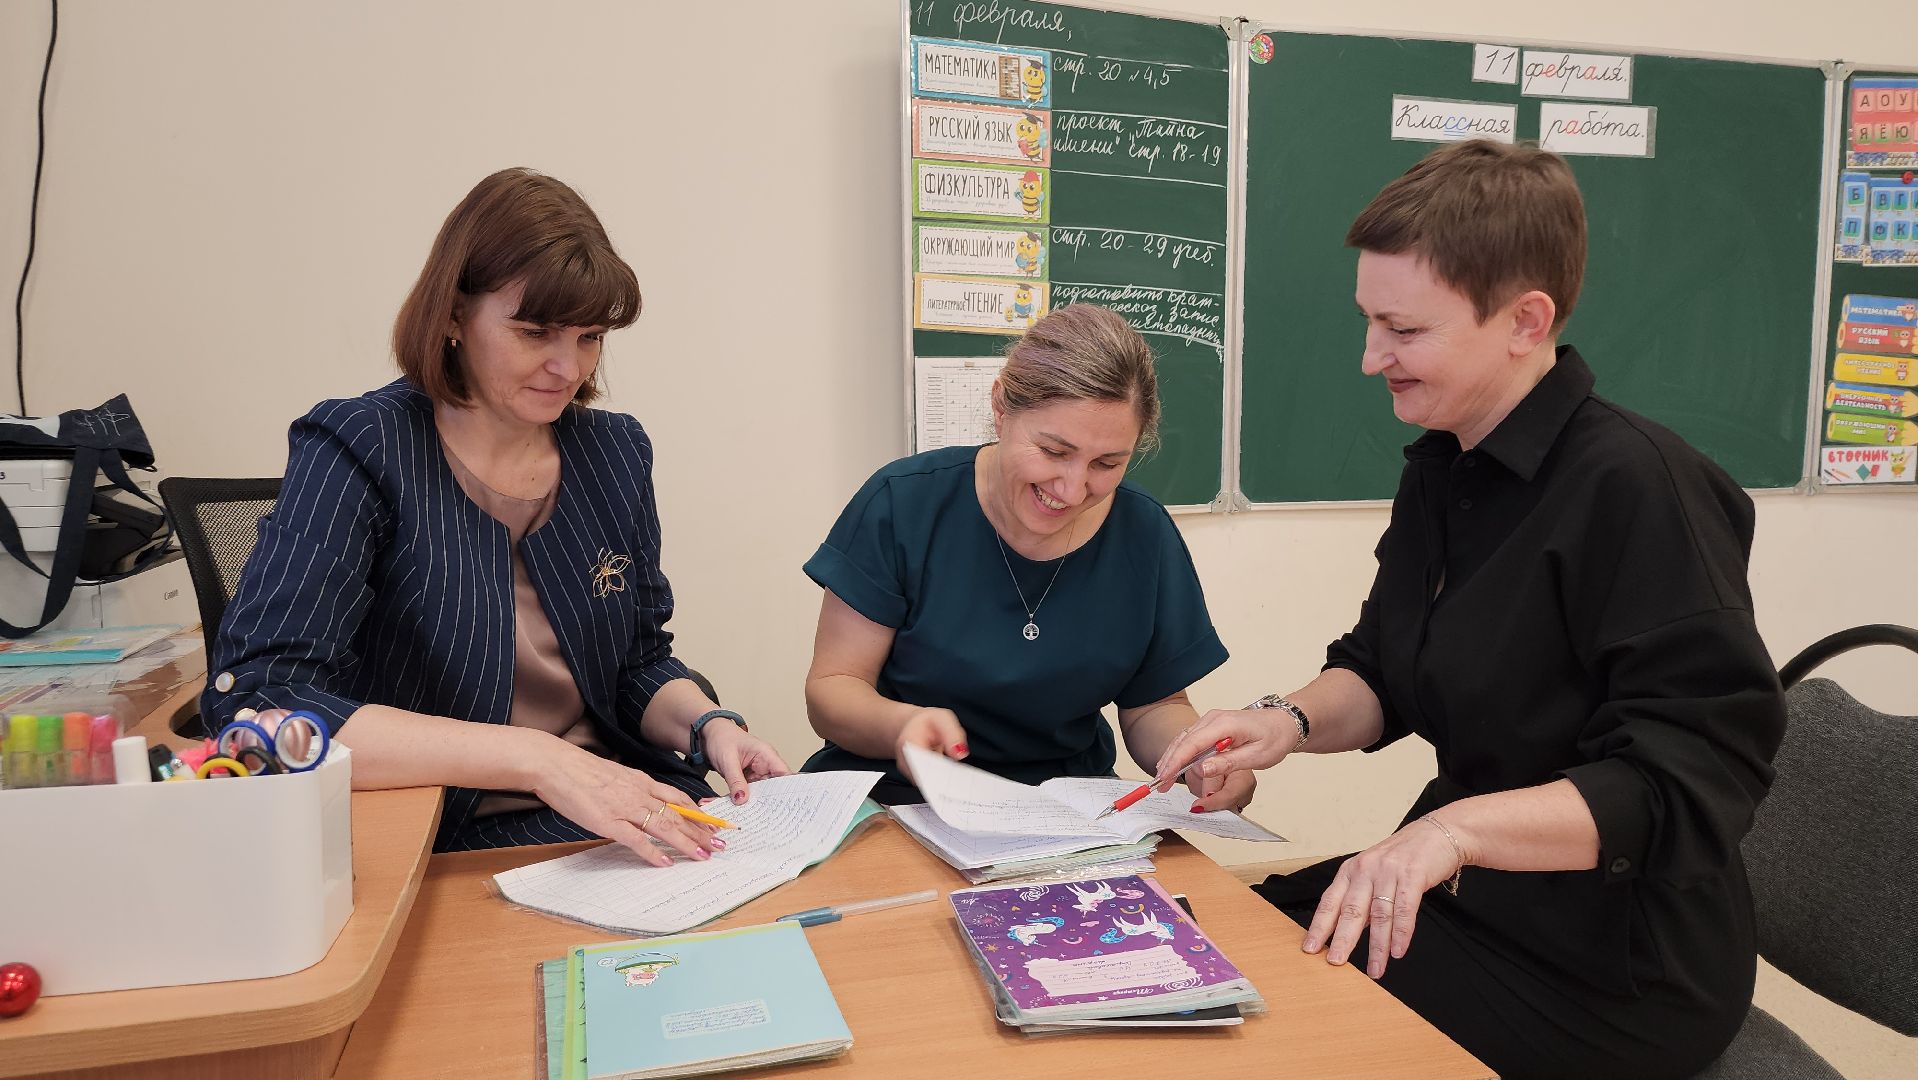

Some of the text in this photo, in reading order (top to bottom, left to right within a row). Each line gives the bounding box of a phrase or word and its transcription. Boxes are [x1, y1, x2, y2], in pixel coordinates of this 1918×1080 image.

[916, 0, 1072, 44] 11 февраля,
[924, 53, 998, 81] МАТЕМАТИКА
[1485, 48, 1517, 75] 11
[1053, 56, 1092, 93] стр.
[1099, 61, 1122, 81] 20
[1860, 93, 1908, 107] А О У
[929, 115, 1013, 143] РУССКИЙ ЯЗЫК
[1056, 114, 1126, 143] проект
[1395, 104, 1511, 136] Классная
[1860, 123, 1908, 140] Я Ё Ю
[1128, 142, 1165, 173] стр.
[924, 173, 1010, 199] ФИЗКУЛЬТУРА
[1852, 187, 1860, 200] Б
[1898, 193, 1905, 206] Г
[1848, 221, 1857, 234] П
[1897, 223, 1906, 236] К
[923, 235, 1016, 259] ОКРУЖАЮЩИЙ МИР
[1052, 228, 1091, 264] стр.
[1100, 230, 1125, 251] 20
[1143, 233, 1169, 259] 29
[1172, 243, 1217, 269] учеб.
[963, 291, 1004, 315] ЧТЕНИЕ
[1850, 306, 1903, 317] МАТЕМАТИКА
[1851, 327, 1889, 337] РУССКИЙ
[1858, 336, 1880, 345] ЯЗЫК
